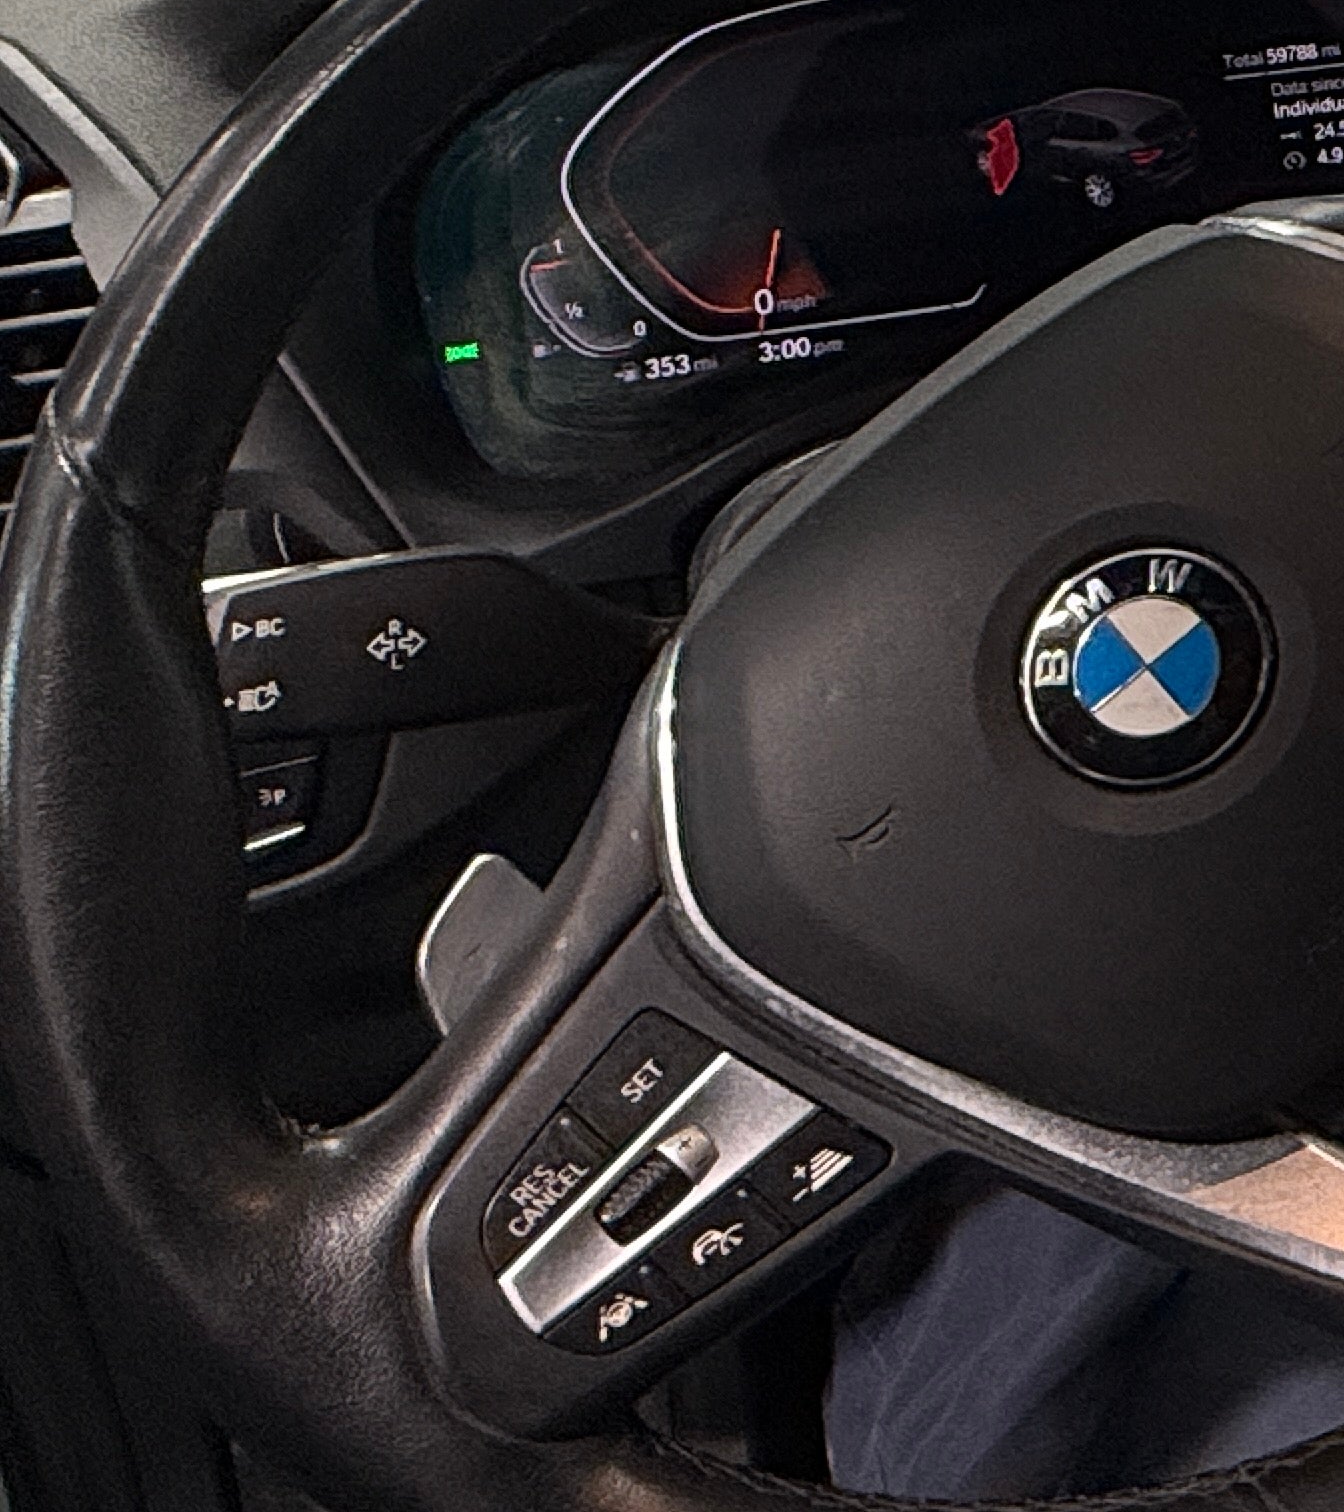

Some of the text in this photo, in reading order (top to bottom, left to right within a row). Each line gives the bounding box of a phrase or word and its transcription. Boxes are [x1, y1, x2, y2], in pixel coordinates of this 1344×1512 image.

[1222, 42, 1342, 69] Total 59788 mi
[1271, 82, 1309, 97] Data
[1317, 146, 1344, 164] 4.9
[552, 238, 564, 254] 1
[754, 288, 818, 315] 0 mph
[633, 320, 646, 337] 0
[758, 336, 845, 363] 3:00 pm
[645, 355, 718, 380] 353 mi
[255, 617, 286, 638] BC
[1035, 558, 1193, 687] BMW
[390, 654, 405, 671] L
[620, 1058, 664, 1105] SET
[508, 1161, 558, 1208] RES
[508, 1161, 589, 1238] CANCEL
